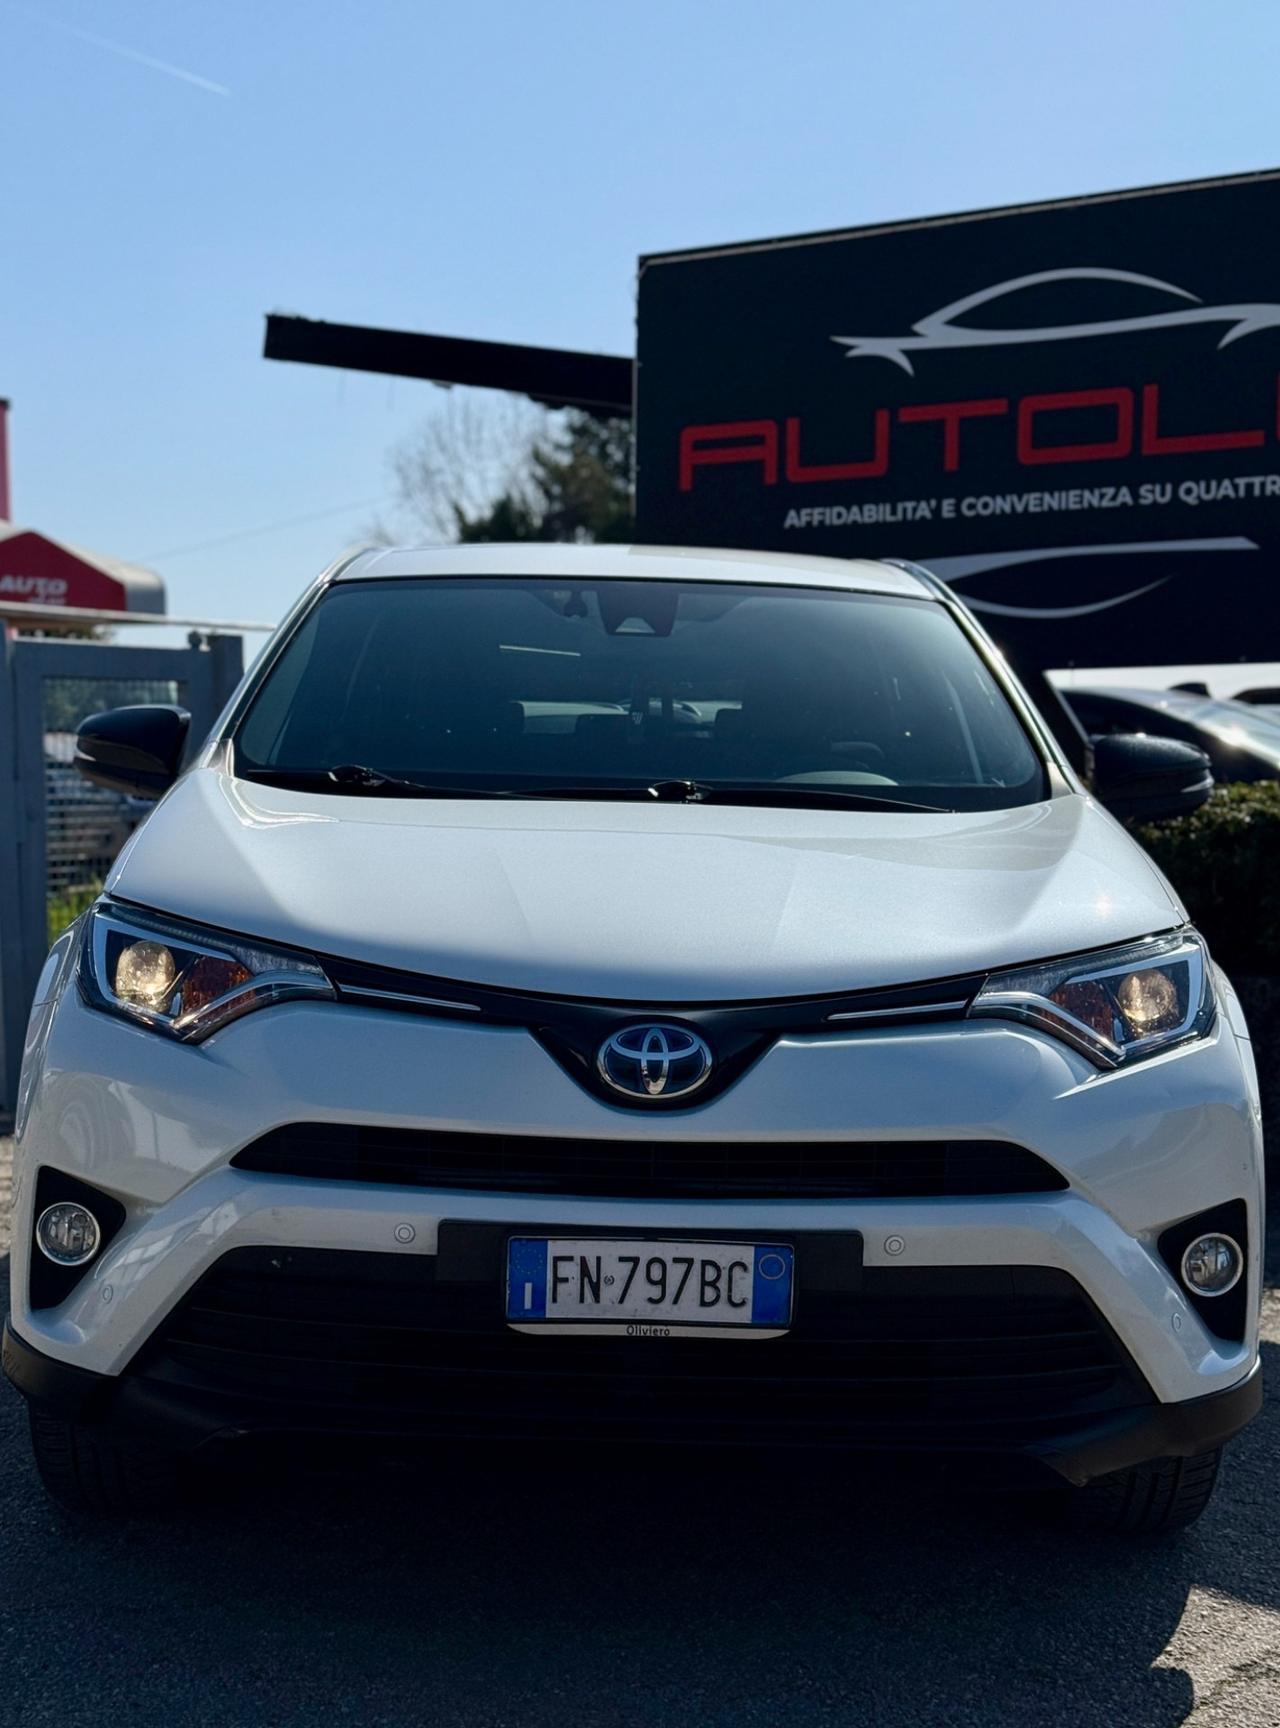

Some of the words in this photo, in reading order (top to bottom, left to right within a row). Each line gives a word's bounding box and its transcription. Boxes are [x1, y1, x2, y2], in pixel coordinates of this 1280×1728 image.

[679, 374, 1280, 491] AUTOL
[784, 499, 937, 529] AFFIDABILITA'
[941, 499, 956, 518] E
[961, 486, 1133, 517] CONVENIENZA
[1139, 482, 1172, 505] SU
[1178, 474, 1280, 506] QUATTR
[0, 575, 68, 594] AUTO
[524, 1282, 532, 1309] I
[626, 1325, 670, 1336] Oliviero
